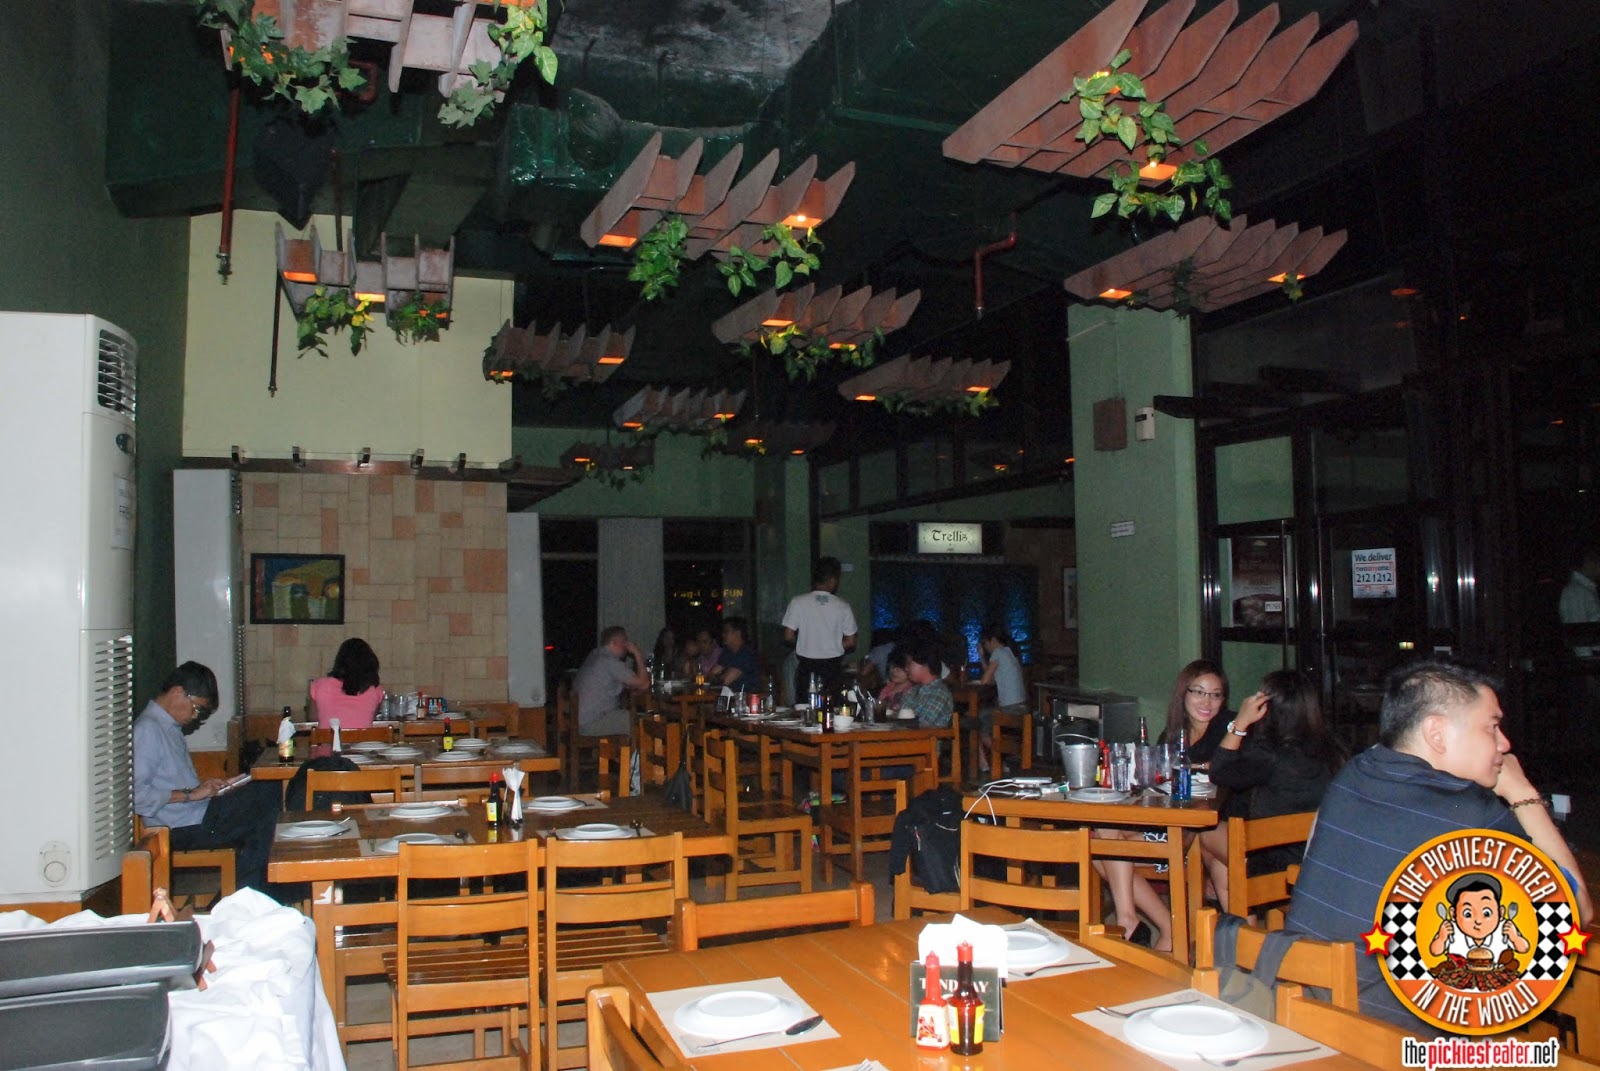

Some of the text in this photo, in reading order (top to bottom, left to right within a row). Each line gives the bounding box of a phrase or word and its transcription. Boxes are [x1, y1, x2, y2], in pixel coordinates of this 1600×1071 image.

[932, 529, 968, 542] Trellis
[1355, 552, 1392, 562] We deliver
[1356, 572, 1392, 583] 212 1212
[919, 977, 989, 993] TNDAY
